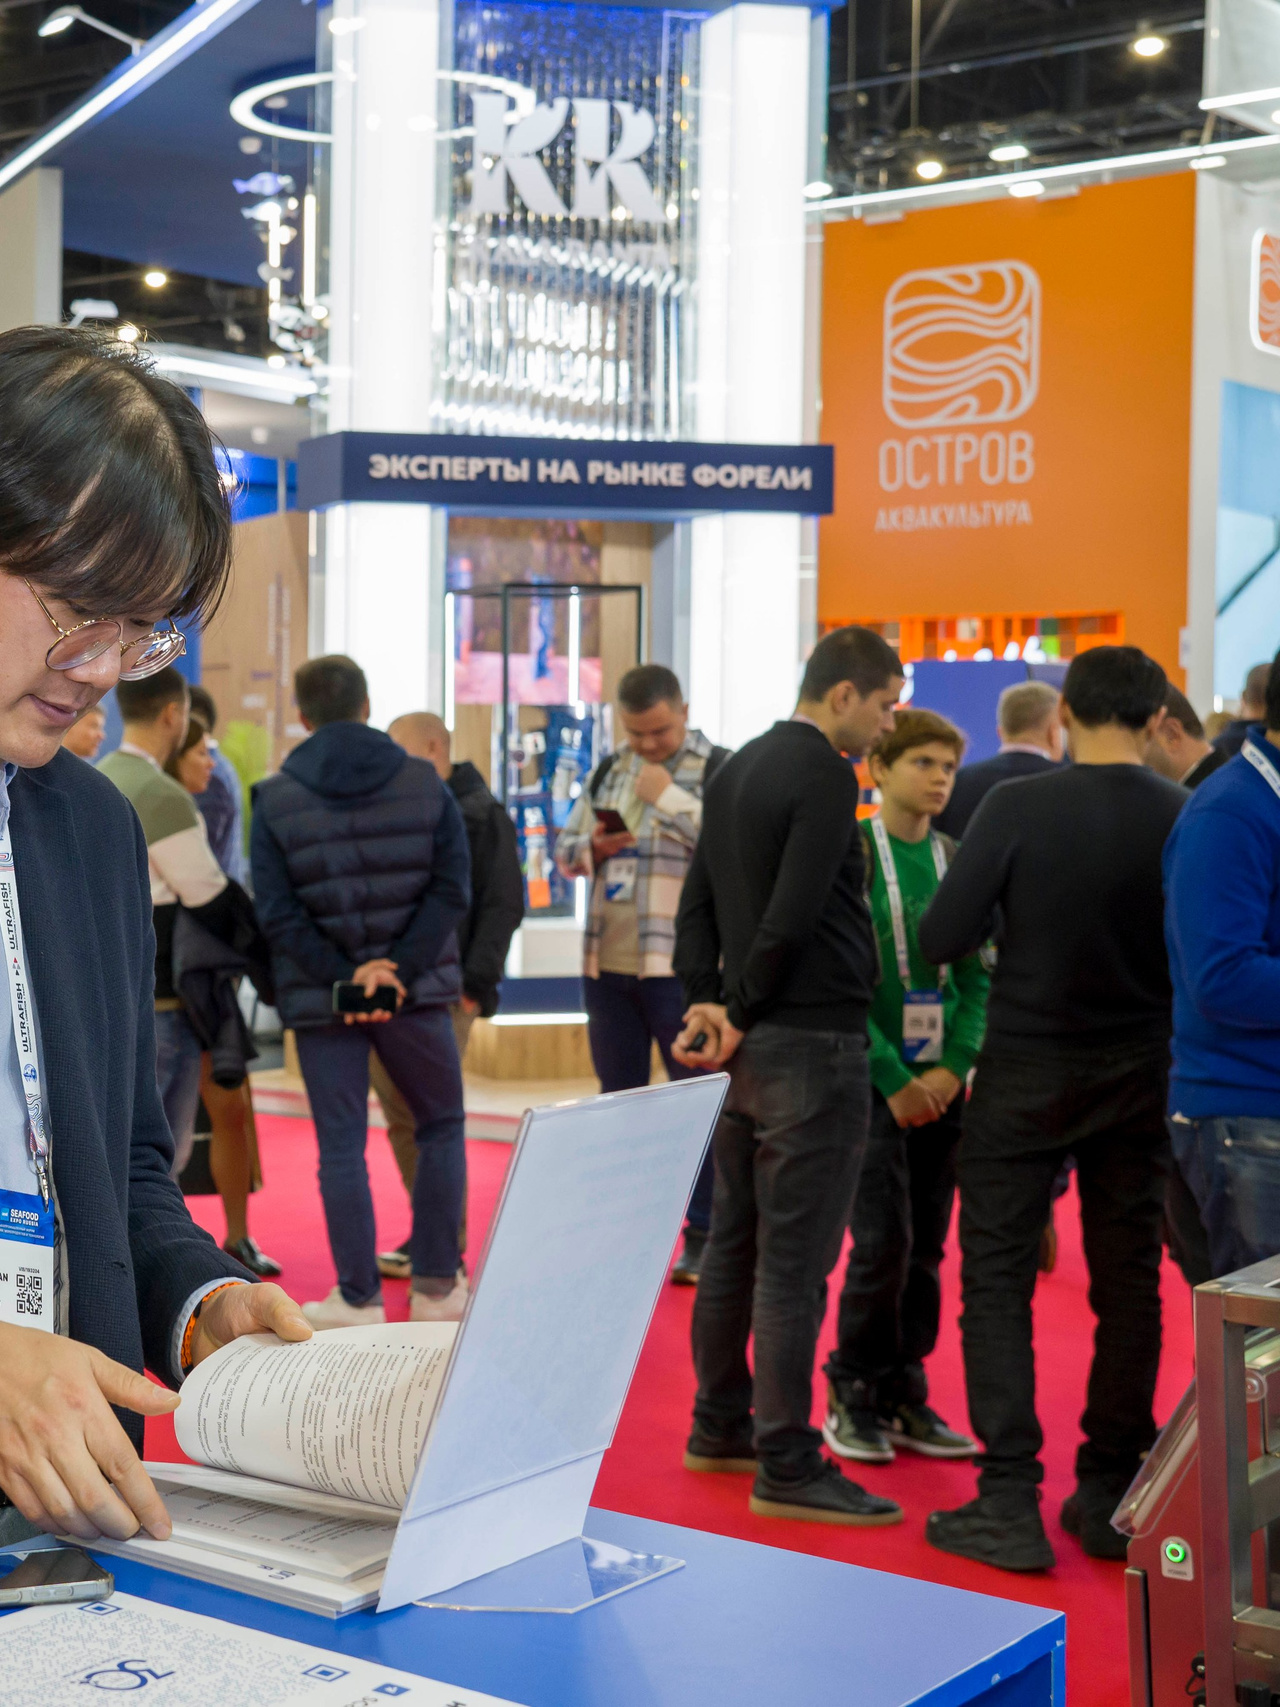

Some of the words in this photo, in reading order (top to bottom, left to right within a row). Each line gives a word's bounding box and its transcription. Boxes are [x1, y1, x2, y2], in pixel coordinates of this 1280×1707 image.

[470, 92, 669, 224] KR
[368, 453, 530, 482] ЭКСПЕРТЫ
[537, 459, 580, 485] НА
[587, 460, 686, 487] РЫНКЕ
[692, 463, 813, 491] ФОРЕЛИ
[878, 430, 1035, 492] ОСТРОВ
[874, 500, 1033, 533] АКВАКУЛЬТУРА
[0, 882, 16, 950] ULTRAFISH
[15, 982, 30, 1053] ULTRAFISH
[10, 1208, 39, 1221] SEAFOOD
[23, 1219, 39, 1227] RUSSIA
